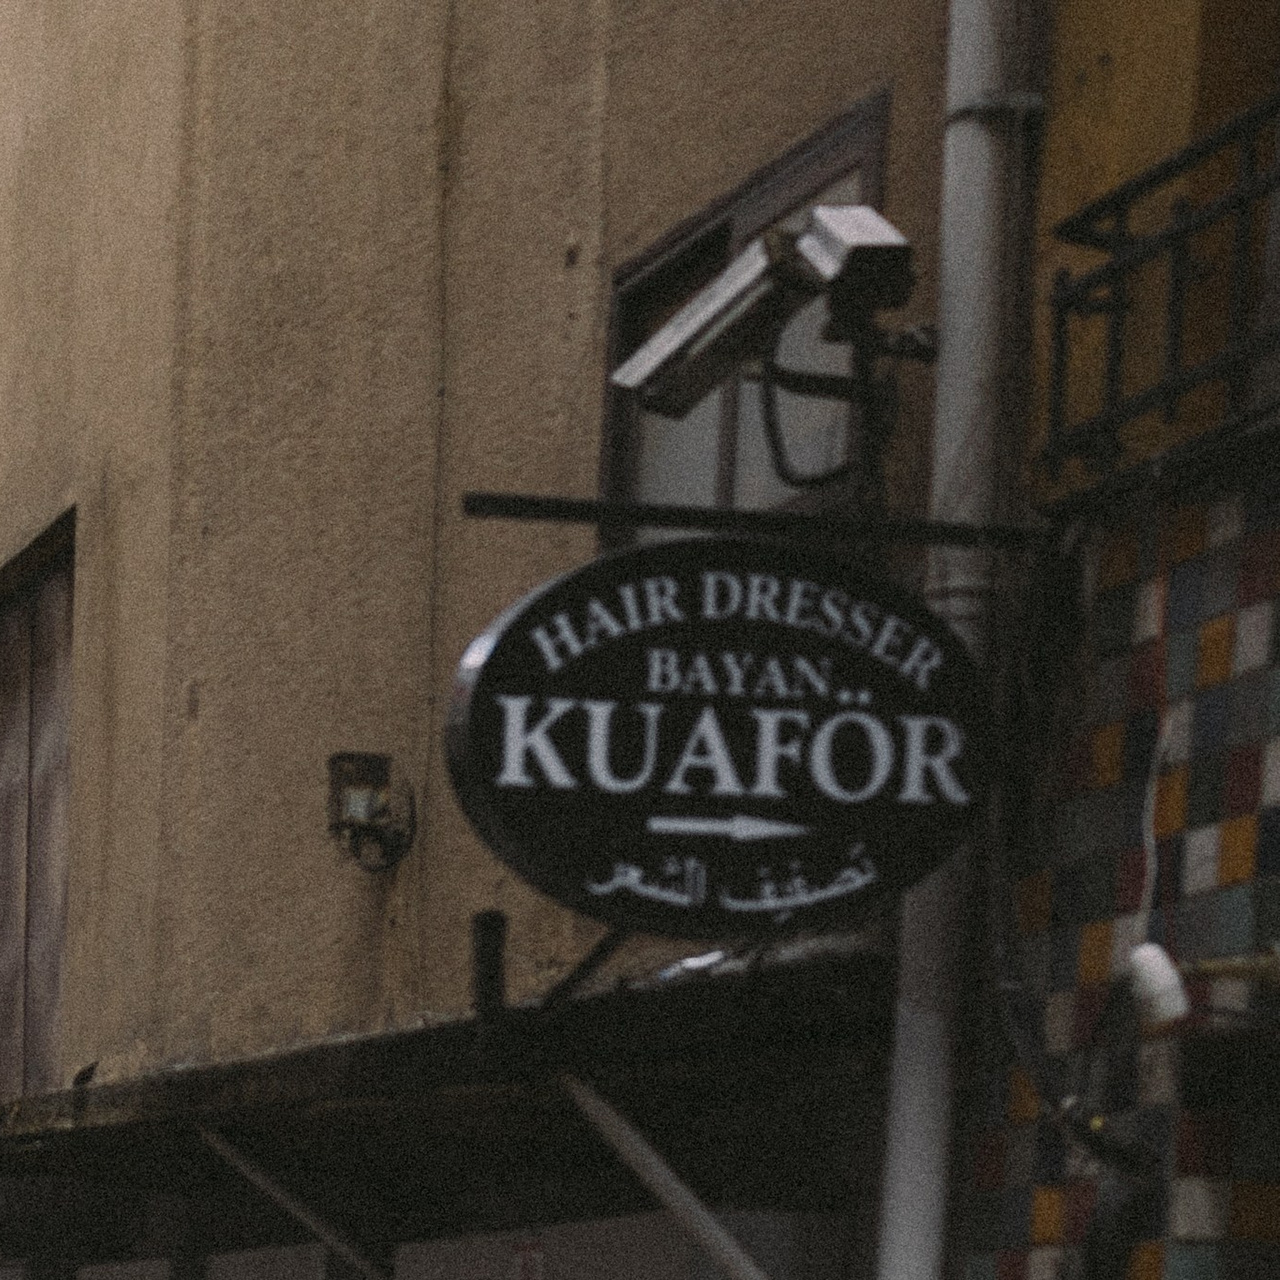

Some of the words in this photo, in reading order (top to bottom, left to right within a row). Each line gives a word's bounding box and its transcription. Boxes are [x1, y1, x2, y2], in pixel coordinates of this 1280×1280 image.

[531, 574, 683, 671] HAIR
[702, 570, 943, 690] DRESSER
[647, 647, 830, 697] BAYAN
[496, 689, 970, 803] KUAFÖR
